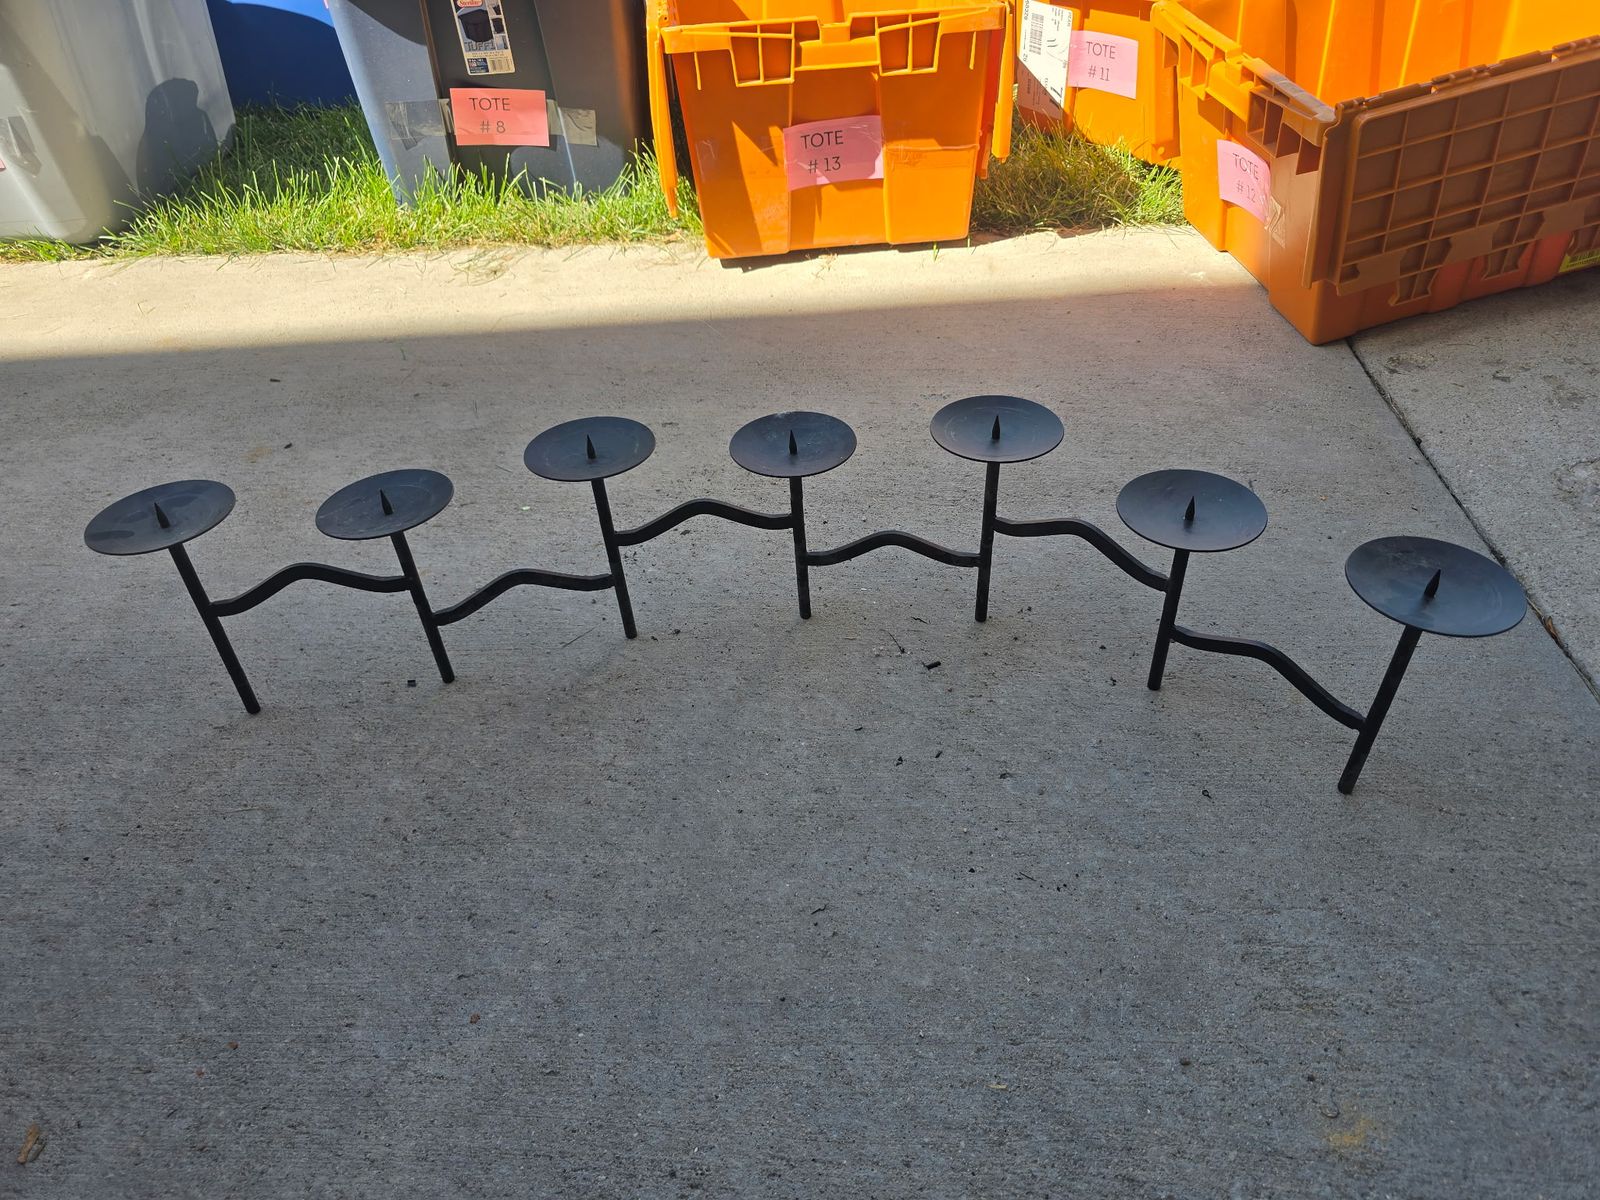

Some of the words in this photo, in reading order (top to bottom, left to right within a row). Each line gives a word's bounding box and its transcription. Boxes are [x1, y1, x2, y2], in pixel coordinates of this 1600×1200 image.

[1086, 40, 1116, 60] TOTE
[468, 96, 511, 111] TOTE
[496, 120, 506, 134] 8
[800, 129, 844, 149] TOTE
[823, 155, 842, 172] 13
[1232, 152, 1259, 181] TOTE
